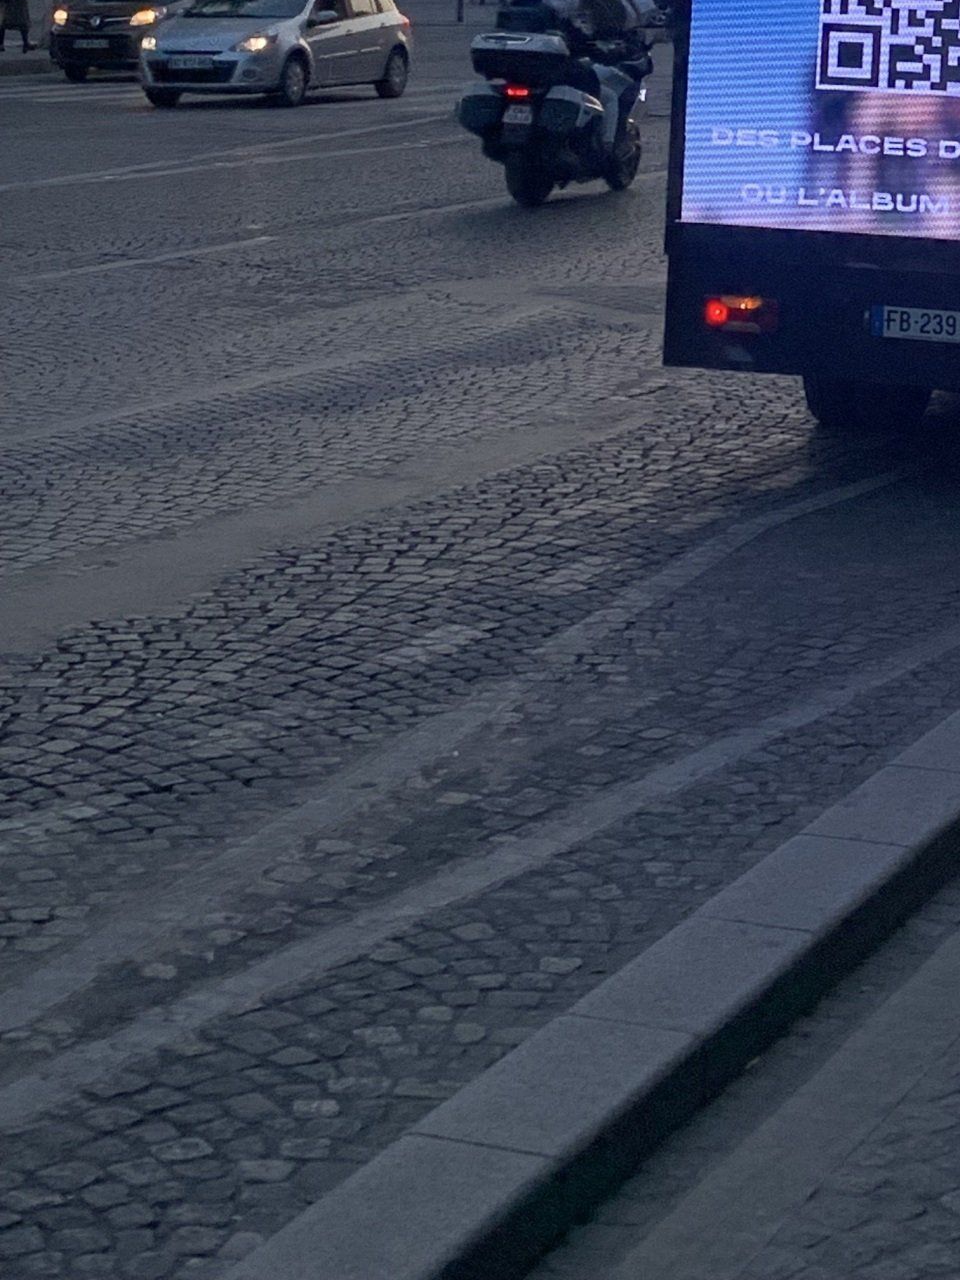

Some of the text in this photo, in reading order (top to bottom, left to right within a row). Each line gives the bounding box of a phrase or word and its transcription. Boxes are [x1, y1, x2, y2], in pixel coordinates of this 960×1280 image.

[711, 129, 779, 146] DES
[790, 132, 928, 157] PLACES
[740, 184, 787, 204] OU
[798, 188, 950, 213] L'ALBUM
